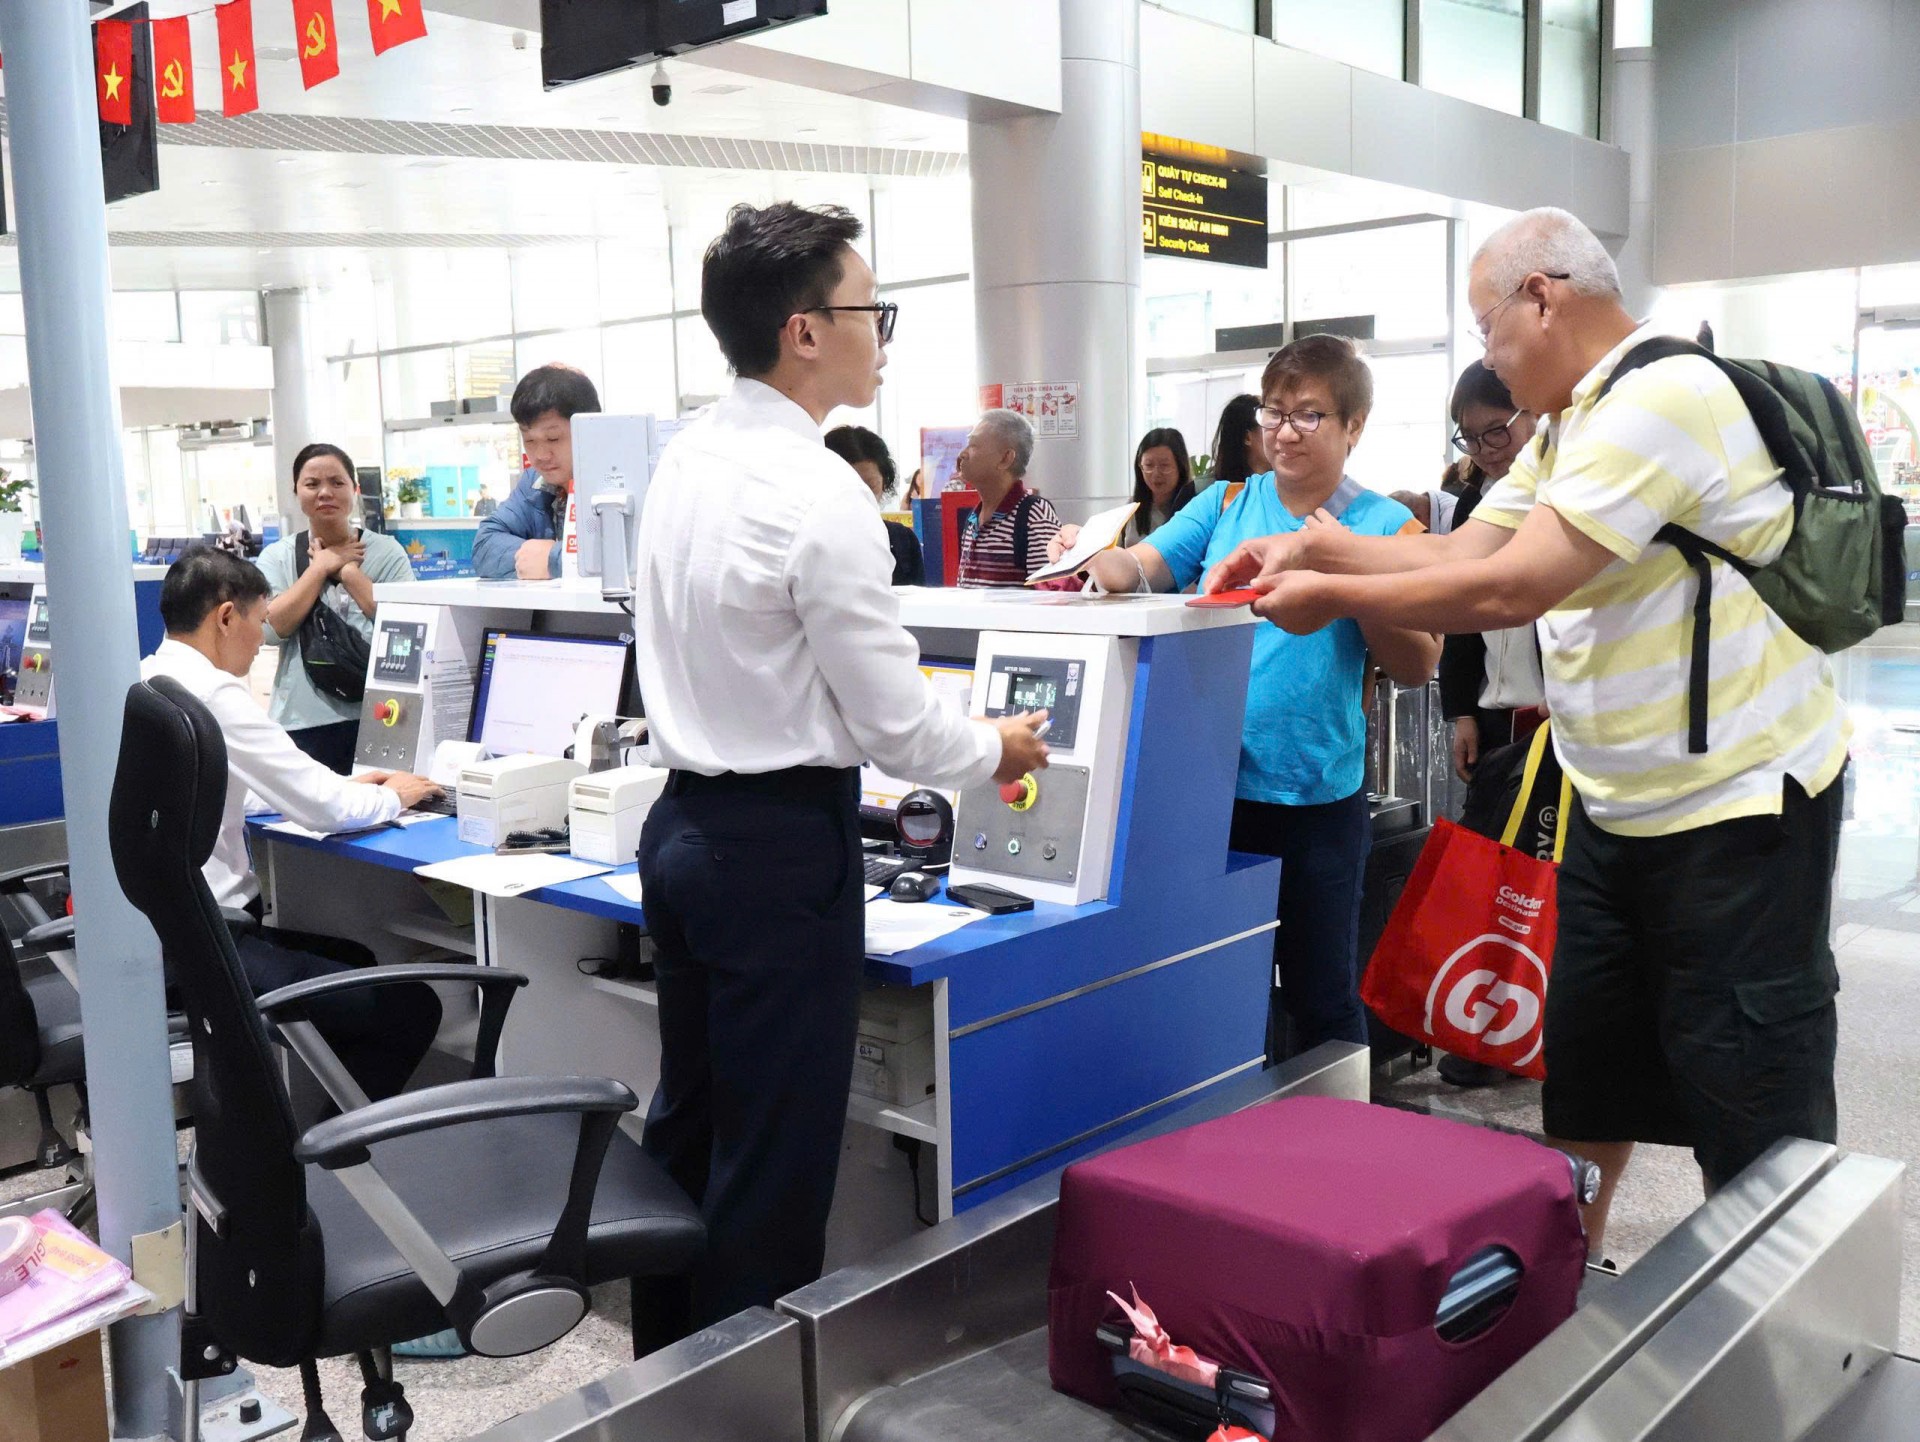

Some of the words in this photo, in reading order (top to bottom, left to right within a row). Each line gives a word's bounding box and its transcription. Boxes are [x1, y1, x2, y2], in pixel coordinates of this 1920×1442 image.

[1193, 172, 1227, 189] CHECK-IN
[1158, 185, 1173, 199] Self
[1173, 188, 1204, 205] Check-in
[1199, 221, 1211, 234] AN
[1159, 235, 1187, 252] Security
[1187, 239, 1210, 254] Check
